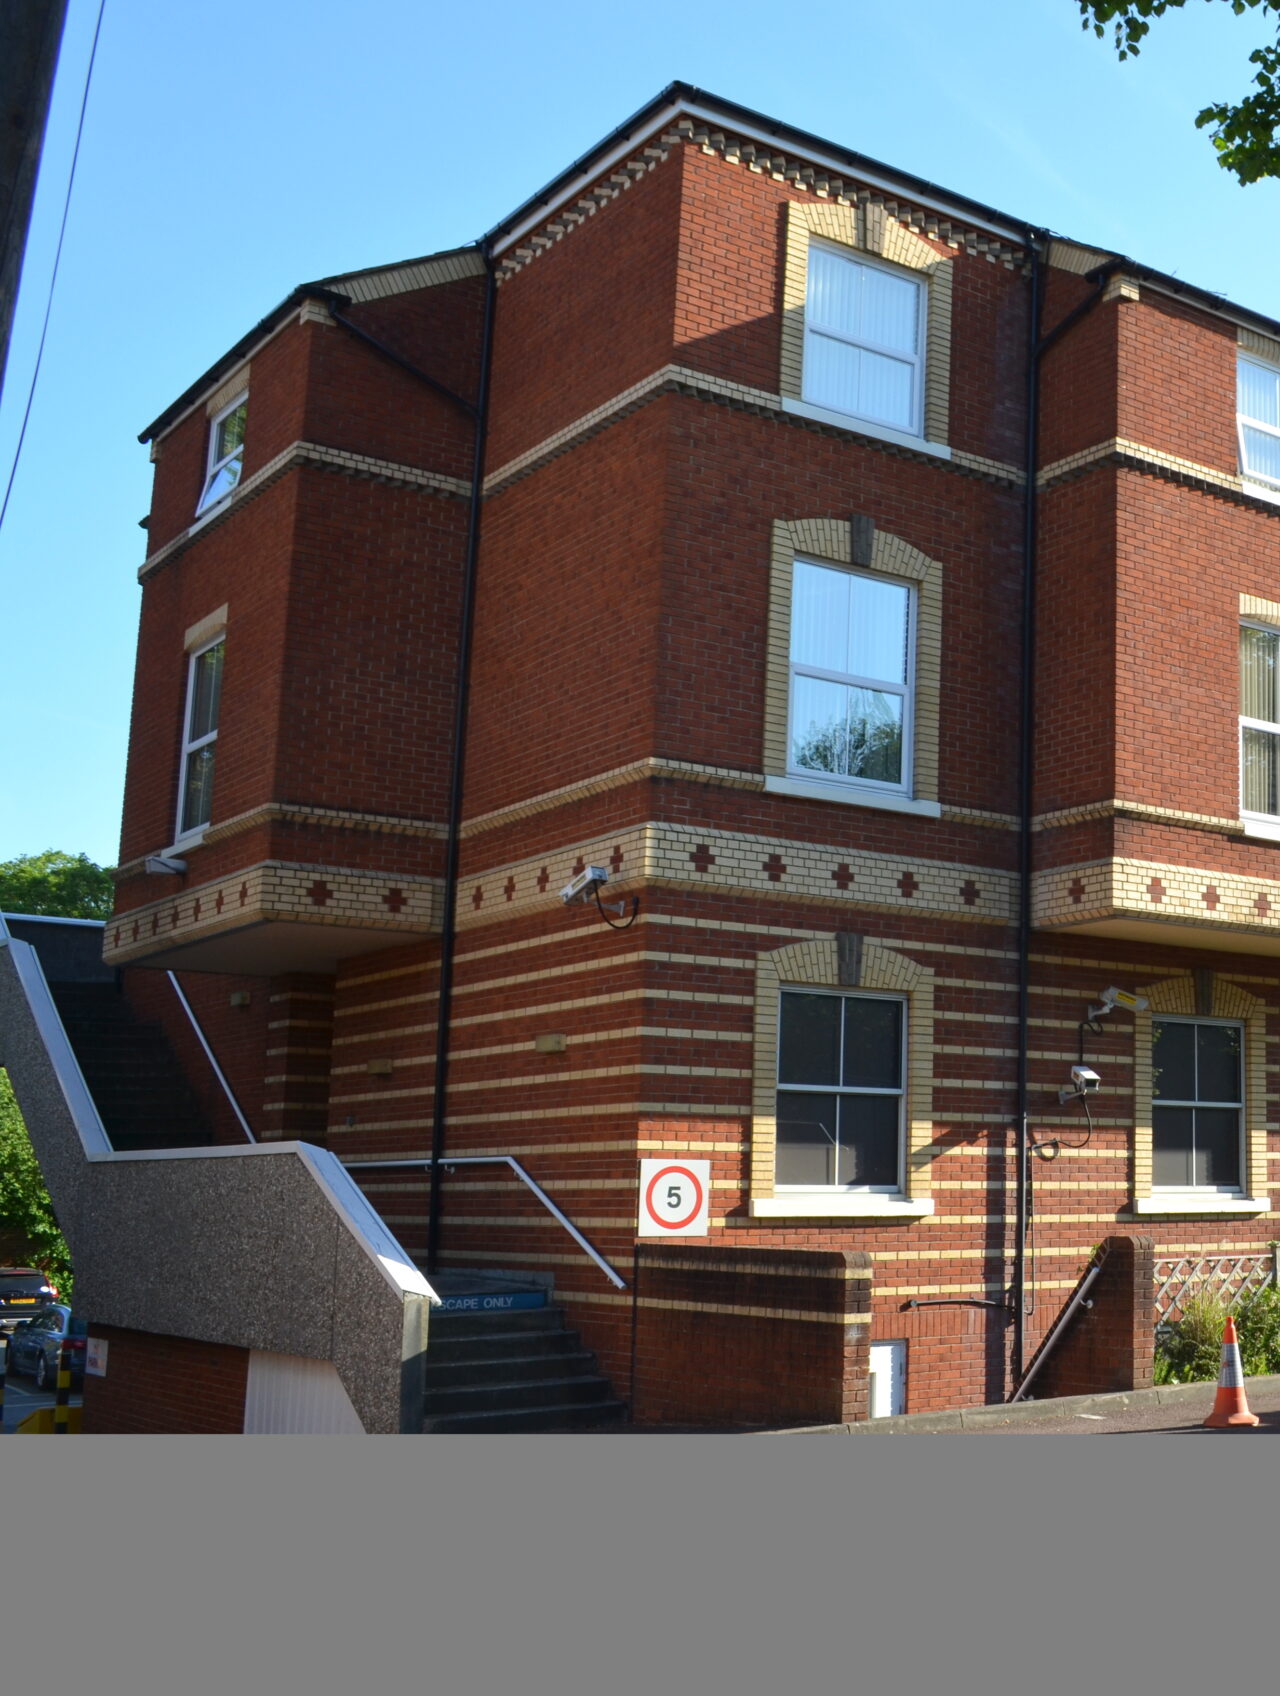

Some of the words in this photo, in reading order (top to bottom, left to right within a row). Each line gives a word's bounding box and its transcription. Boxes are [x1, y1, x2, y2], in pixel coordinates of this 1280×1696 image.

[666, 1186, 682, 1208] 5
[431, 1298, 479, 1311] SCAPE
[483, 1297, 513, 1309] ONLY
